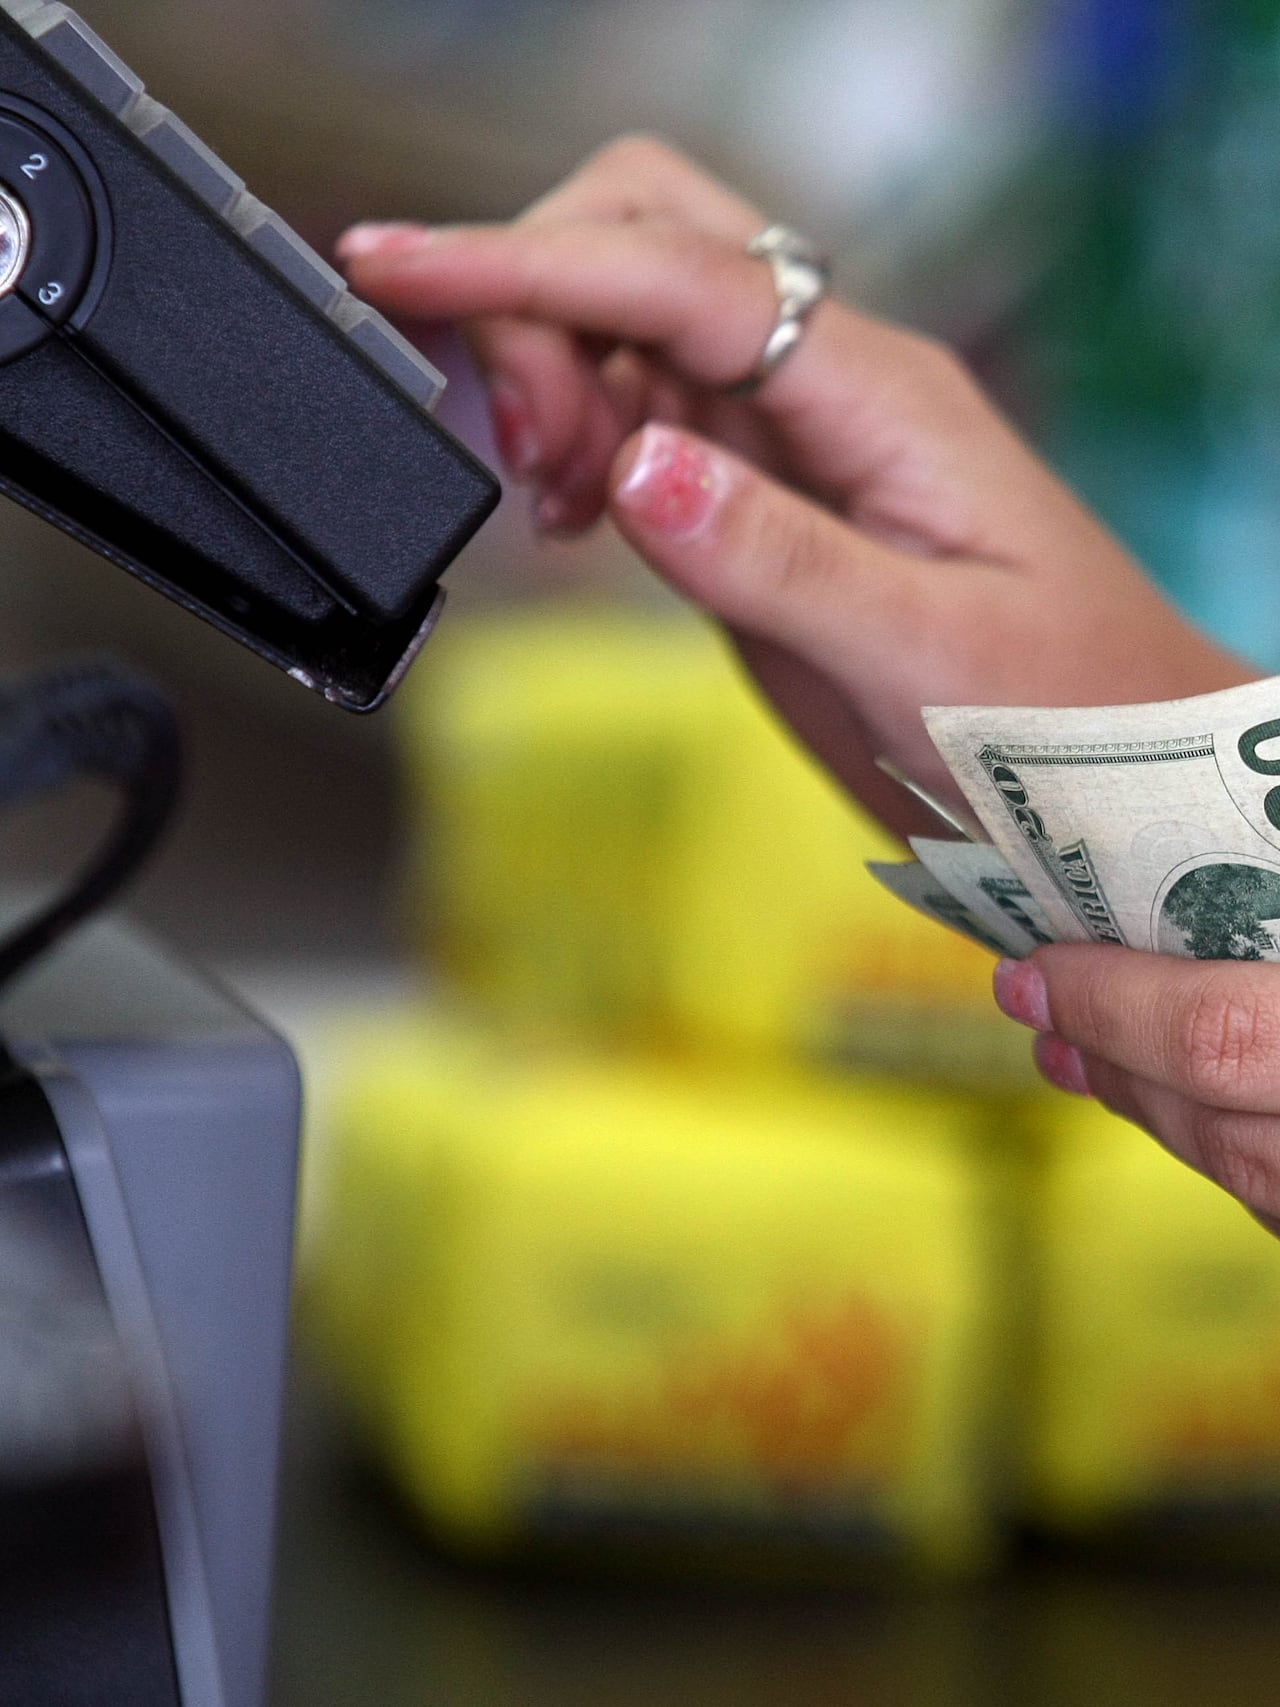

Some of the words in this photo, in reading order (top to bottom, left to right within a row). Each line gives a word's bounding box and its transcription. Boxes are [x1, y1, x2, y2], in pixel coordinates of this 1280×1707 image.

[20, 153, 47, 180] 2
[38, 281, 63, 305] 3
[991, 763, 1053, 843] 20
[1055, 838, 1128, 946] ERICA
